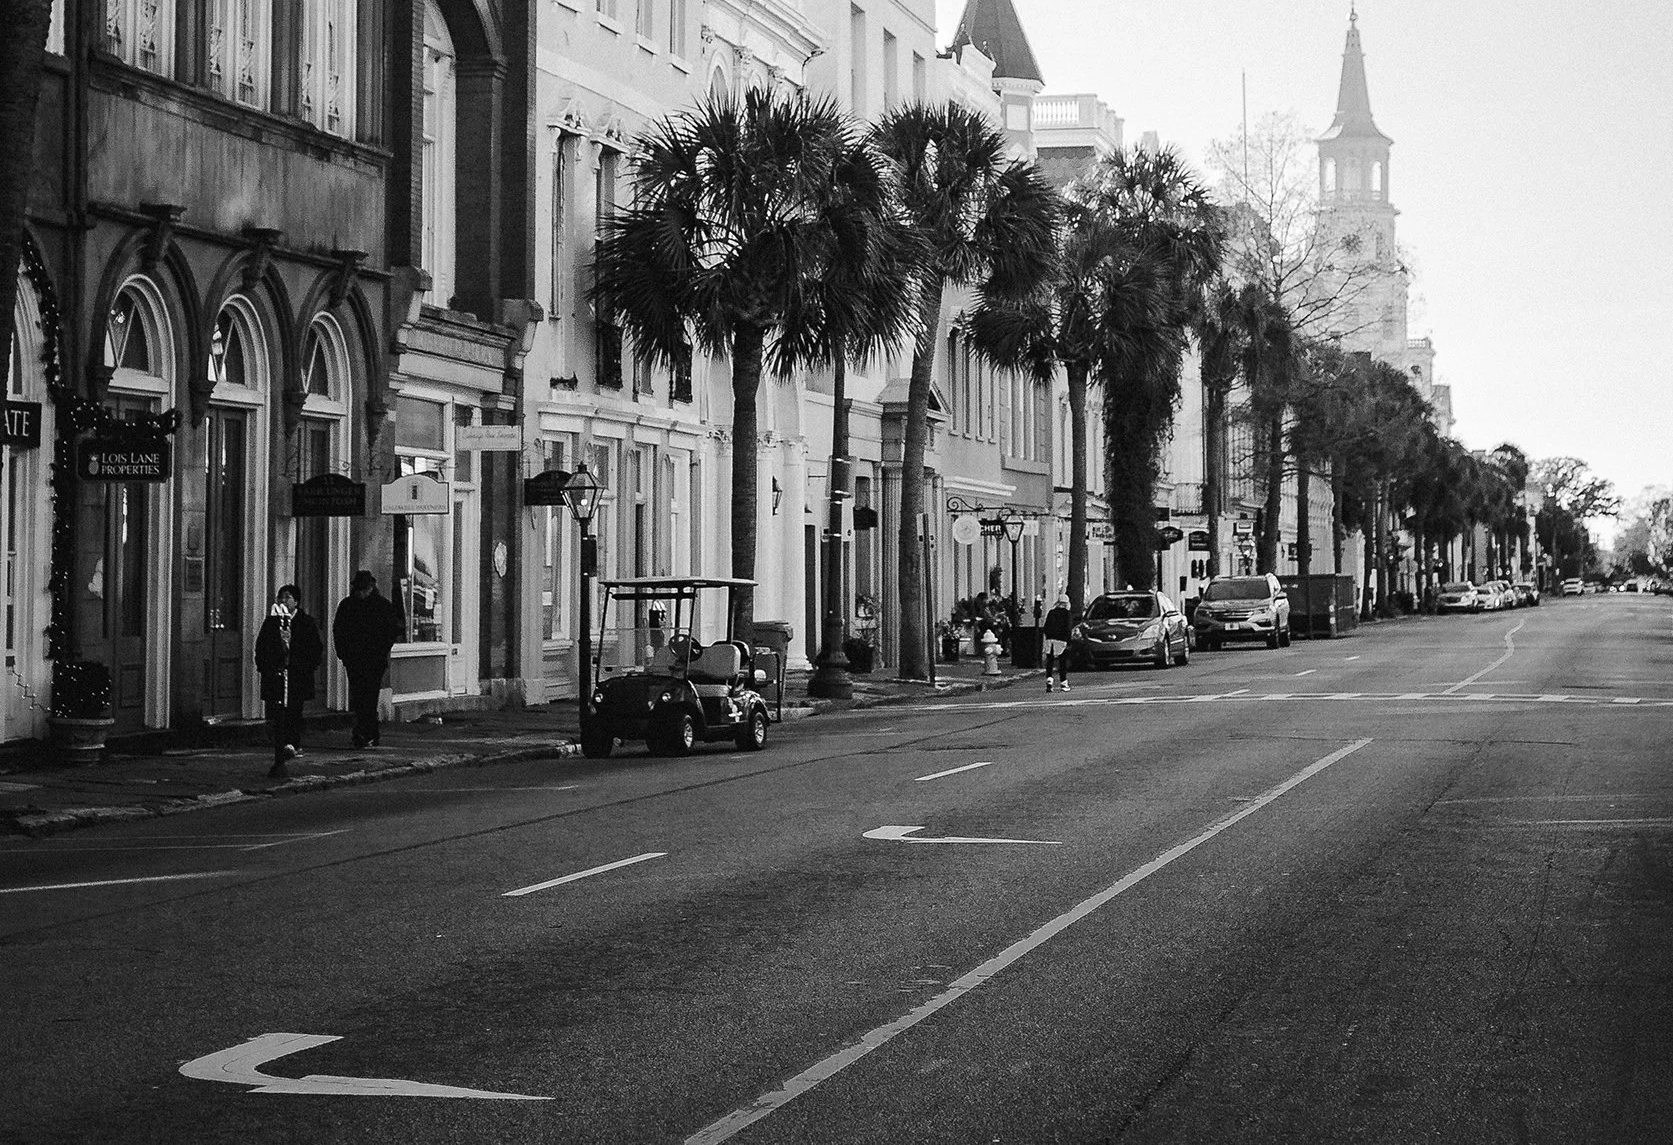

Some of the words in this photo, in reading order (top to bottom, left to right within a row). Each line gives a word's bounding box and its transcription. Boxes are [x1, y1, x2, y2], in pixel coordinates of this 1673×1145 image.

[101, 452, 127, 464] LOIS
[130, 452, 160, 464] LANE
[101, 465, 160, 475] PROPERTIES
